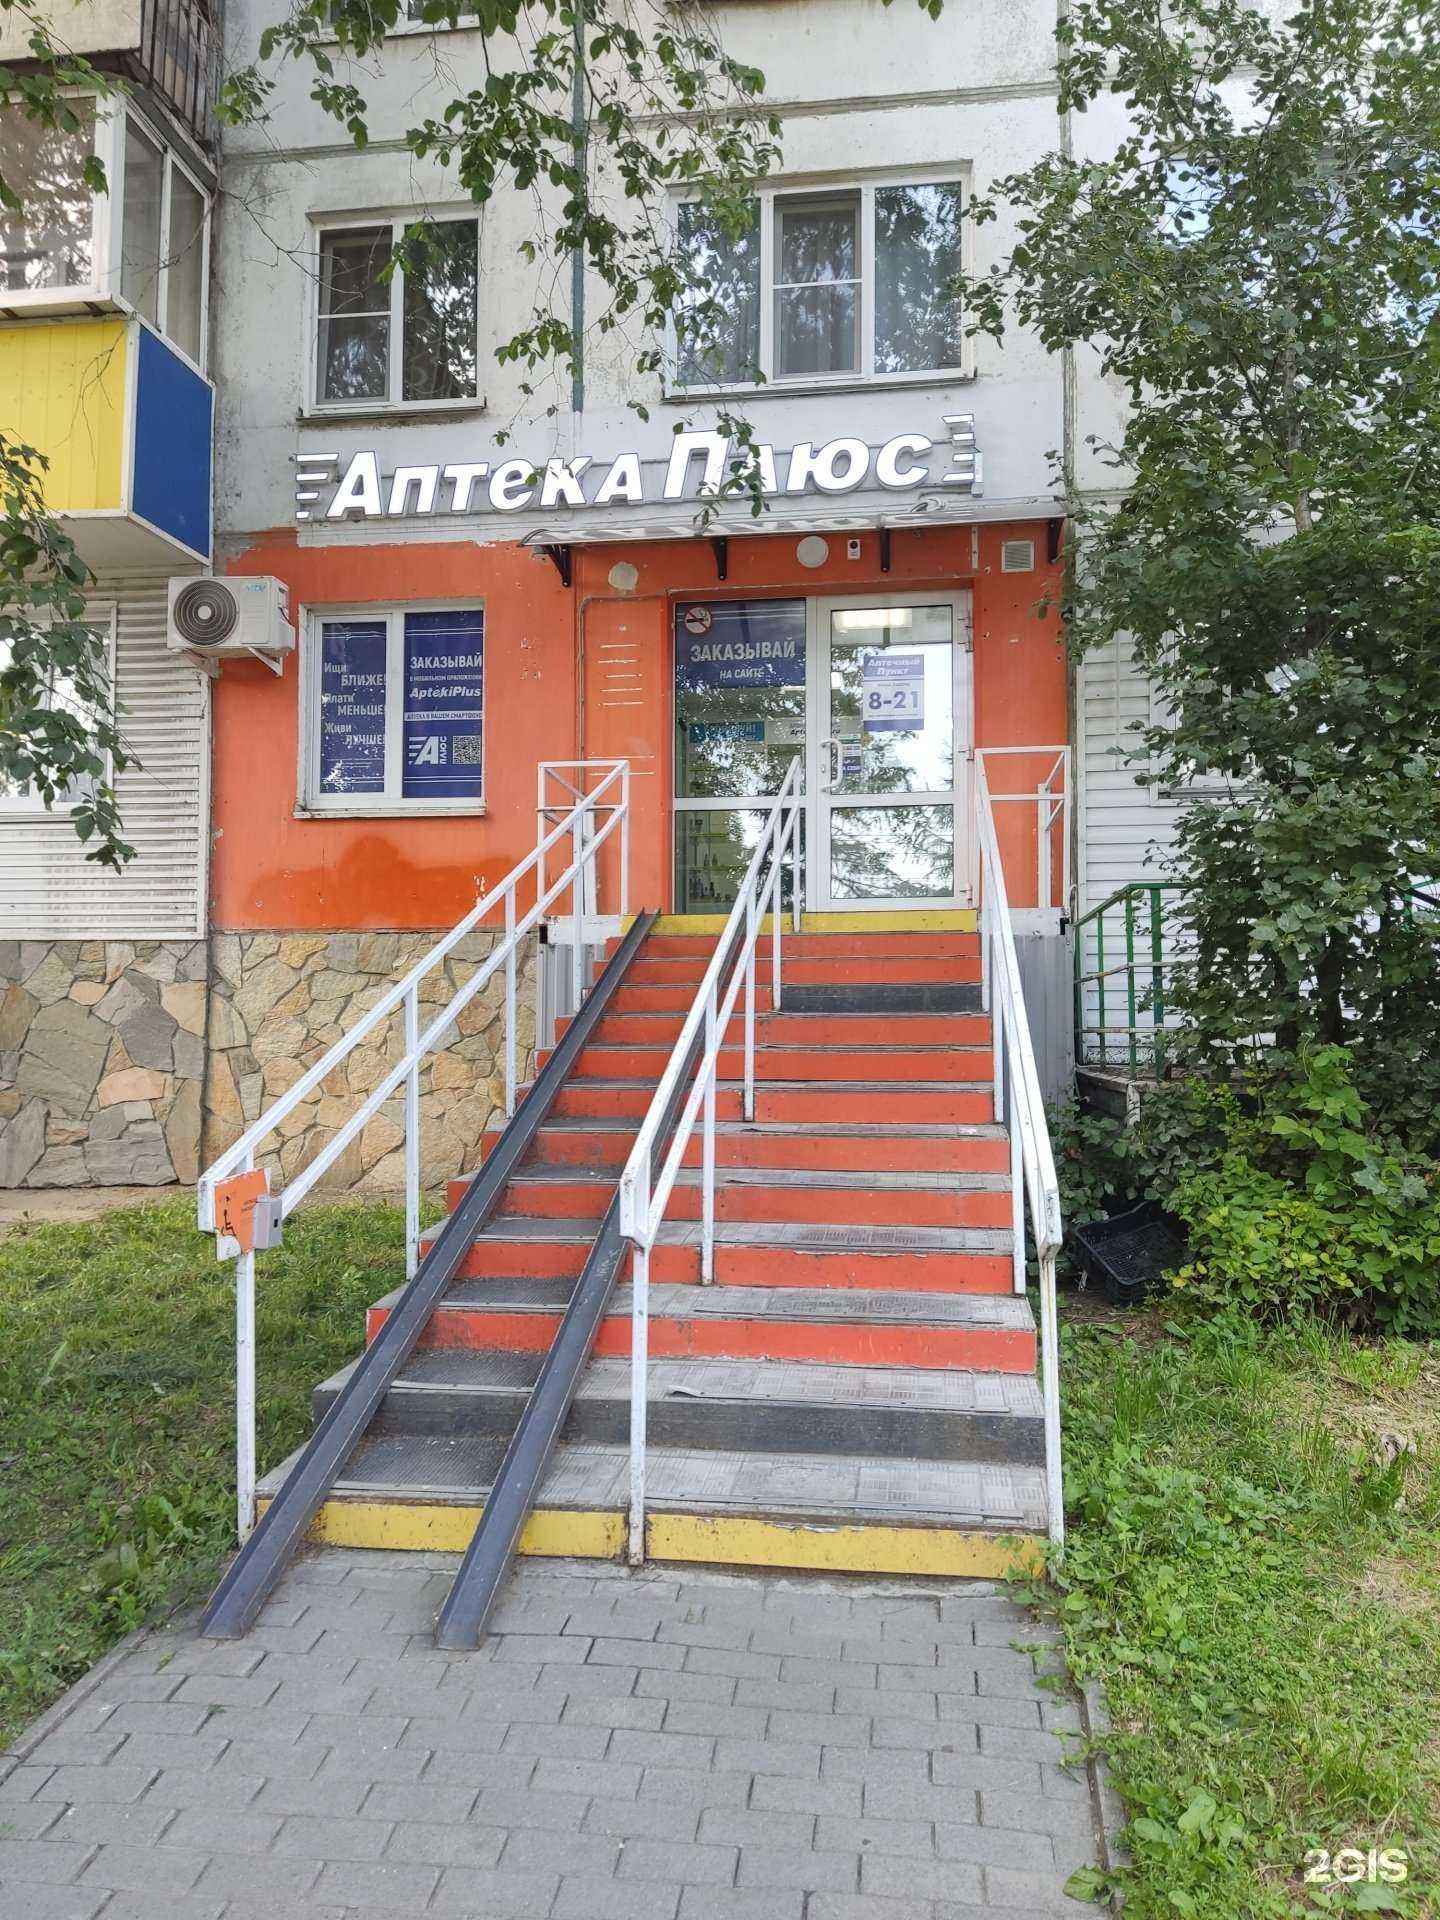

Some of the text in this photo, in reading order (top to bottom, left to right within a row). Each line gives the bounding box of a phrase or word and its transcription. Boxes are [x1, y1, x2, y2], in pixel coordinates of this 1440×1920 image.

[690, 636, 796, 662] ЗАКАЗЫВАЙ
[410, 651, 482, 669] ЗАКАЗЫВАЙ
[324, 662, 348, 674] Ищи
[720, 667, 764, 680] НА САЙТЕ
[323, 693, 354, 704] Плати
[409, 686, 481, 700] AptekiPlus
[869, 691, 920, 710] 8-21
[324, 722, 352, 734] Живи
